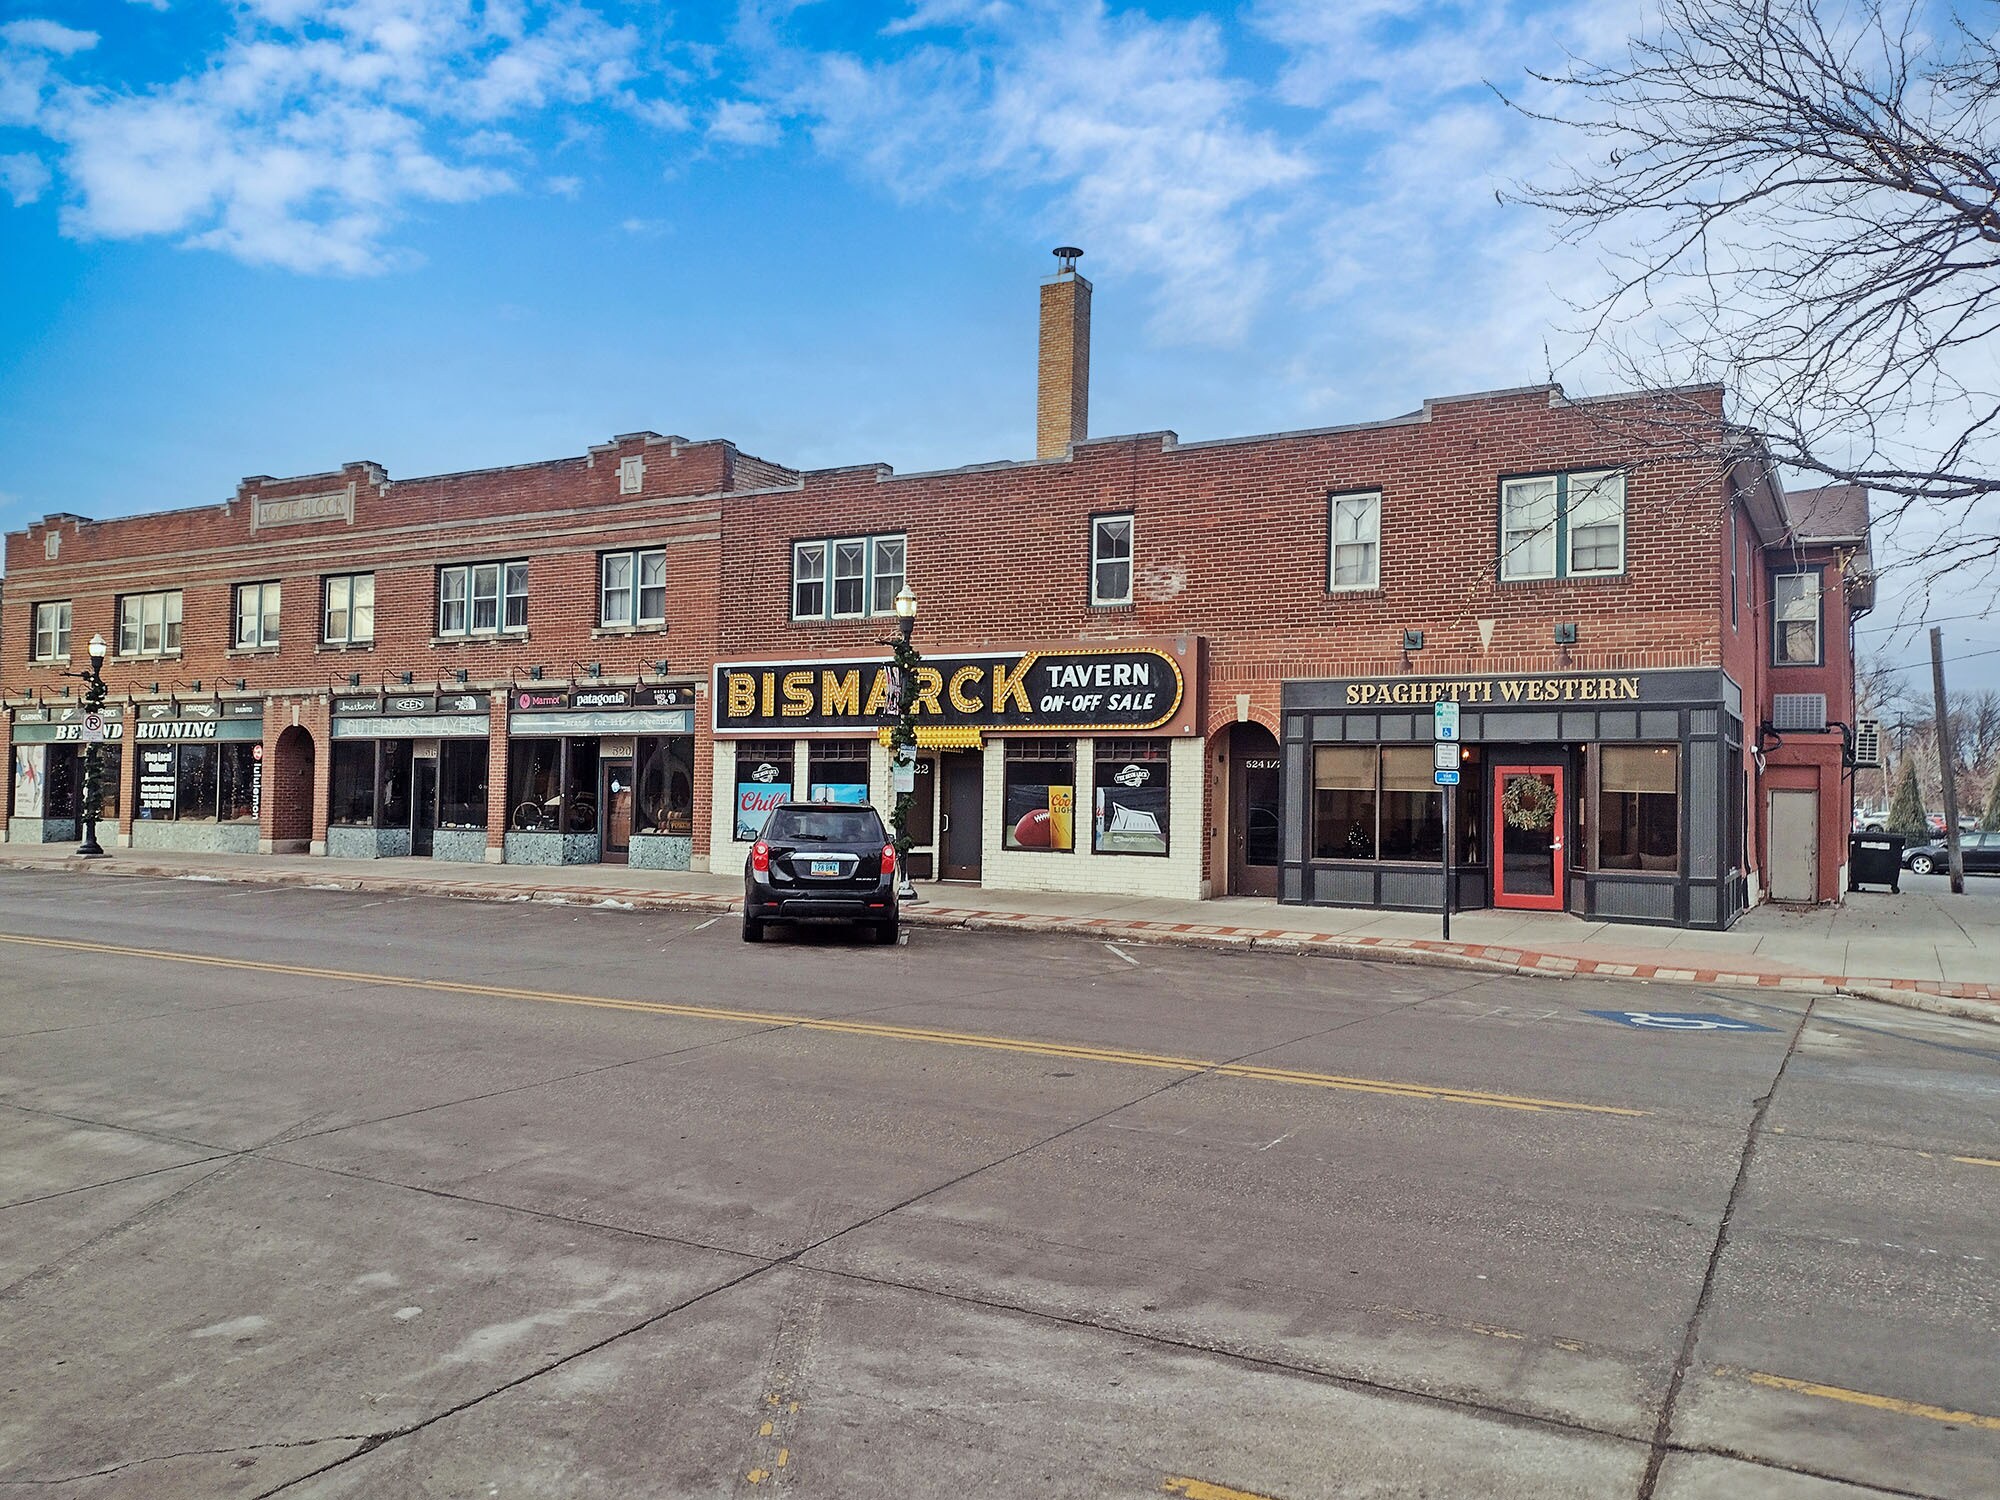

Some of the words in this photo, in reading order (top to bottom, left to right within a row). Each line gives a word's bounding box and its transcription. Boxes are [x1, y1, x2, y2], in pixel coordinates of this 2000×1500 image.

[261, 501, 299, 522] AGGIE
[301, 496, 344, 517] BLOCK
[1046, 662, 1150, 689] TAVERN
[727, 665, 1033, 717] BISMARCK
[1346, 680, 1492, 705] SPAGHETTI
[1496, 676, 1640, 703] WESTERN
[397, 699, 423, 710] KEEN
[576, 692, 624, 706] patagonia
[1040, 694, 1102, 712] ON-OFF
[1107, 693, 1155, 710] SALE
[19, 713, 42, 721] GARMIN
[55, 724, 122, 740] BEND
[136, 722, 215, 739] RUNNING
[424, 749, 437, 757] 516
[612, 746, 631, 756] 520
[914, 763, 929, 774] 22
[1246, 760, 1264, 769] 524
